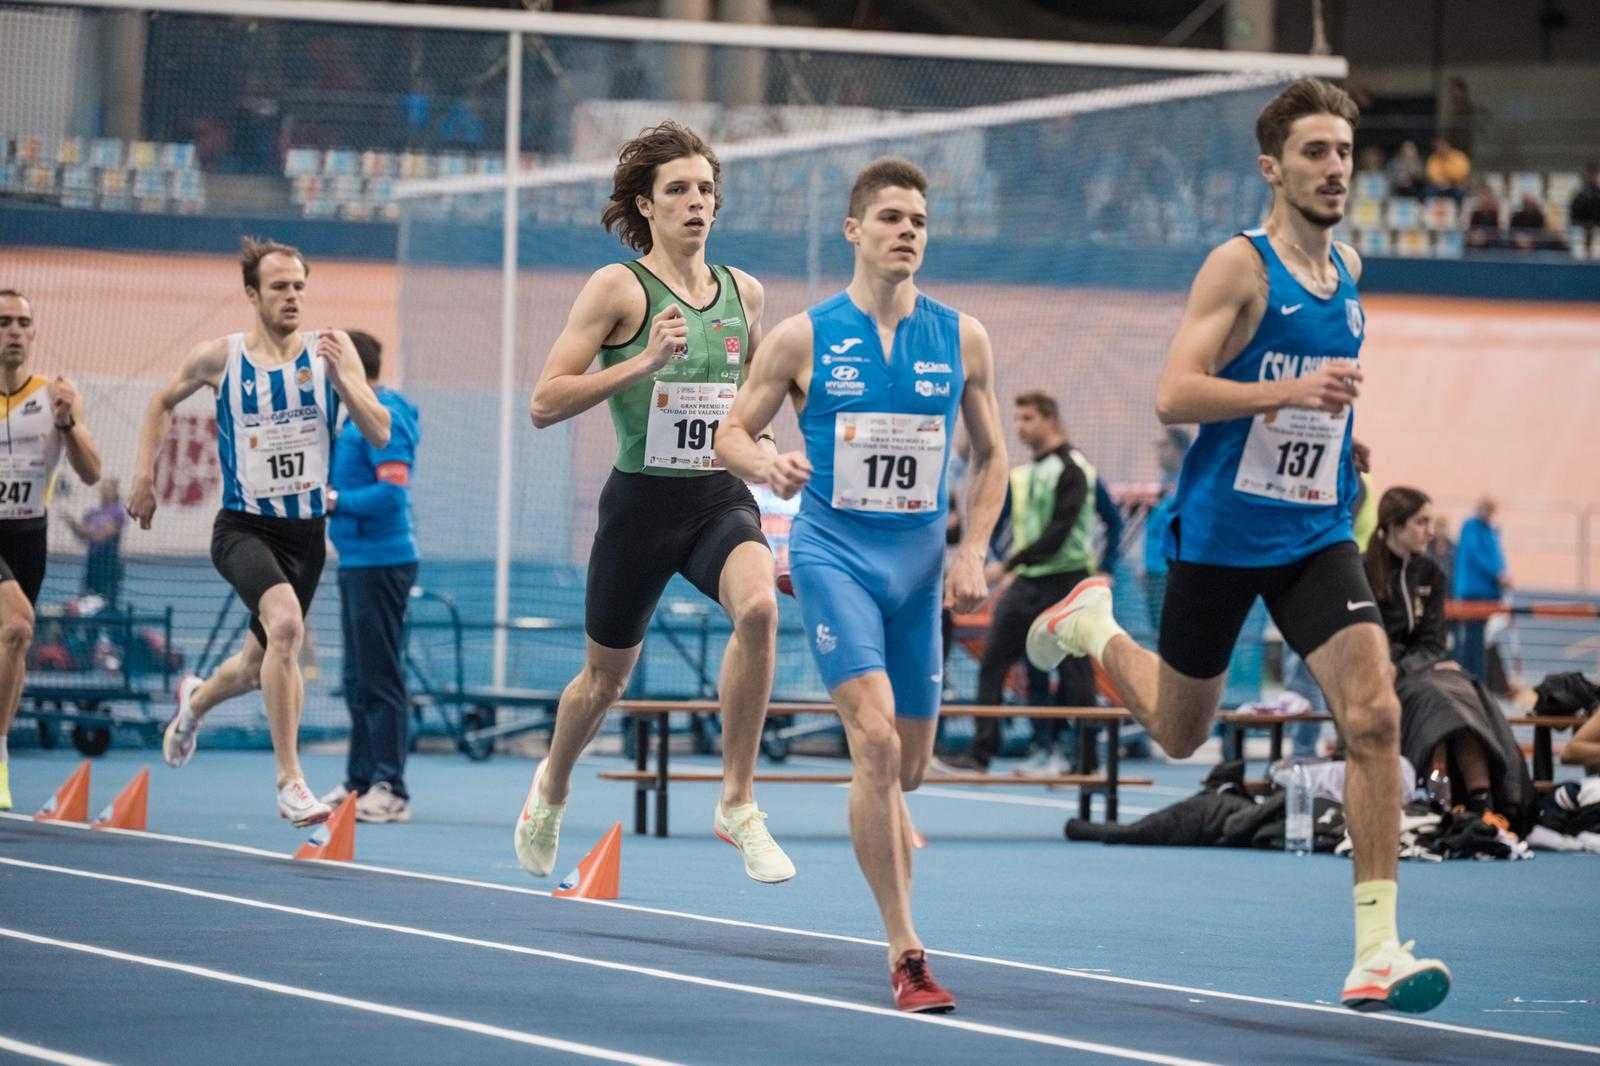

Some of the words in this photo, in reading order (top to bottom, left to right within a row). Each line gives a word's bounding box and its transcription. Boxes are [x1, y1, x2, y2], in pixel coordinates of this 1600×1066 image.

[1259, 351, 1300, 383] CSM
[674, 418, 719, 450] 191
[267, 451, 304, 479] 157
[863, 454, 917, 490] 179
[1276, 440, 1326, 479] 137
